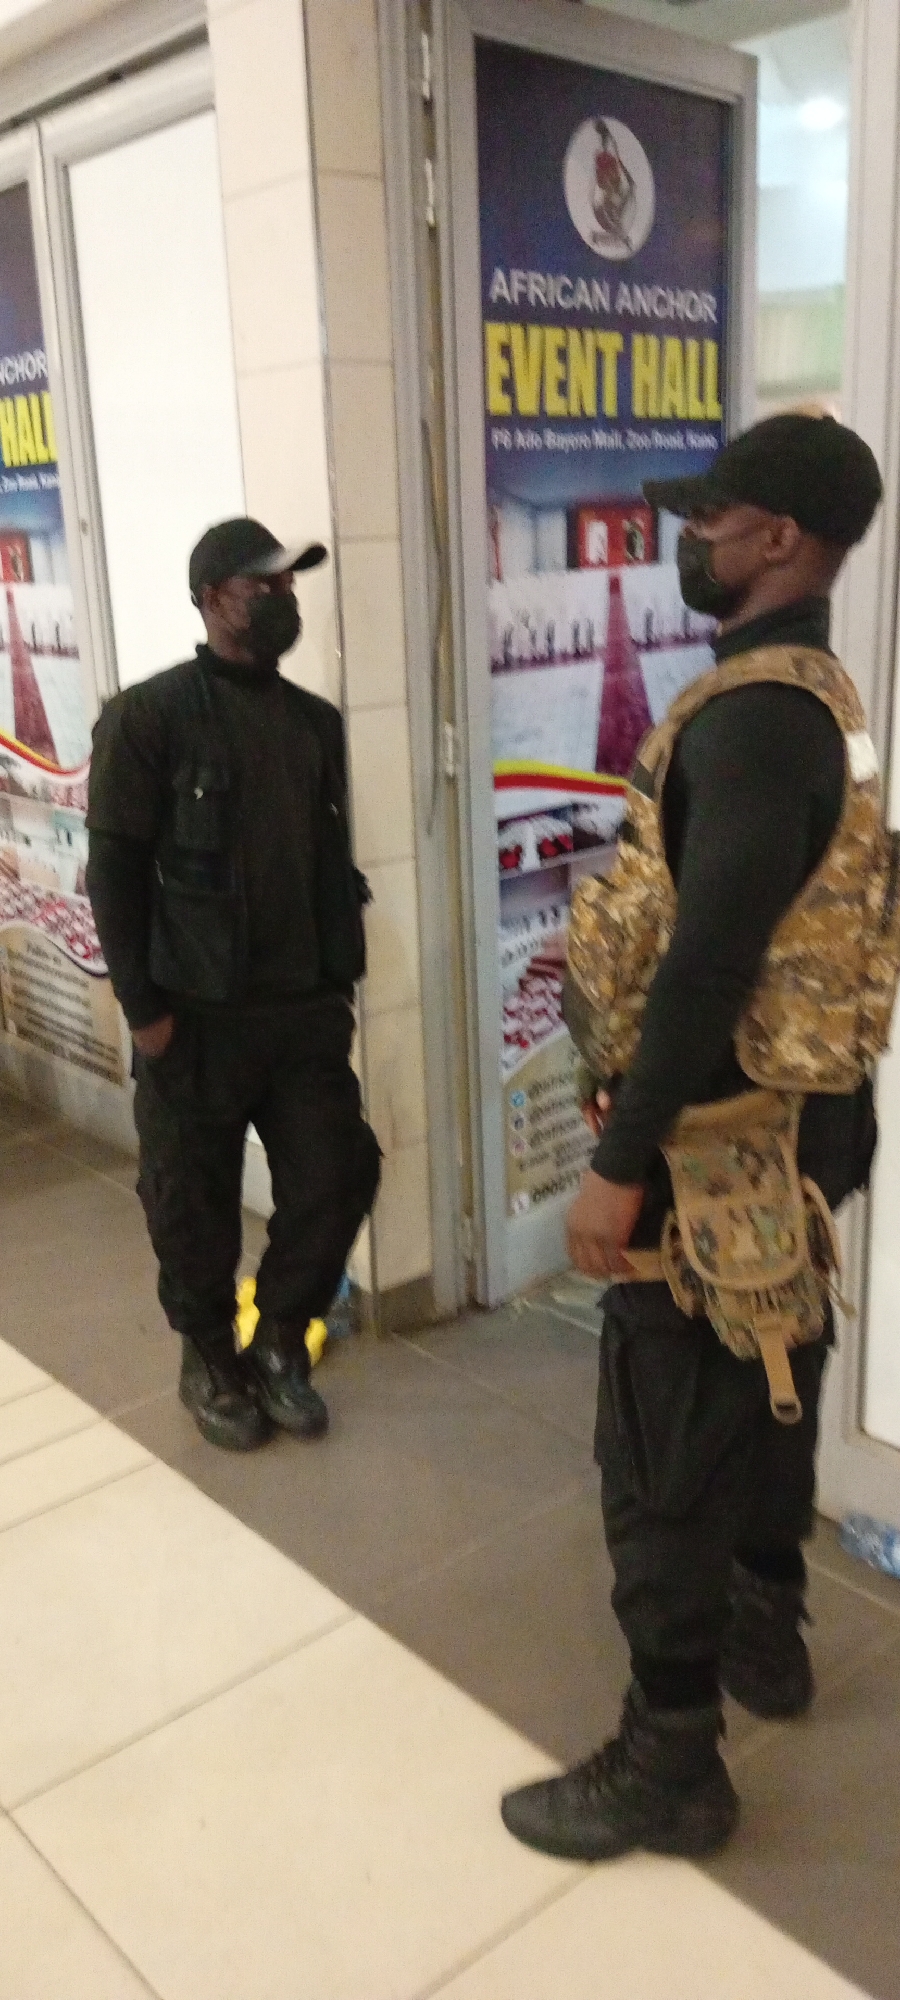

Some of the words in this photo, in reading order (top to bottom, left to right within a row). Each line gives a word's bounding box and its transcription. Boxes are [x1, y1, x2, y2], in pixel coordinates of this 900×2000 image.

[489, 266, 611, 313] AFRICAN
[615, 280, 718, 324] ANCHOR
[485, 322, 624, 419] EVENT
[631, 331, 722, 421] HALL
